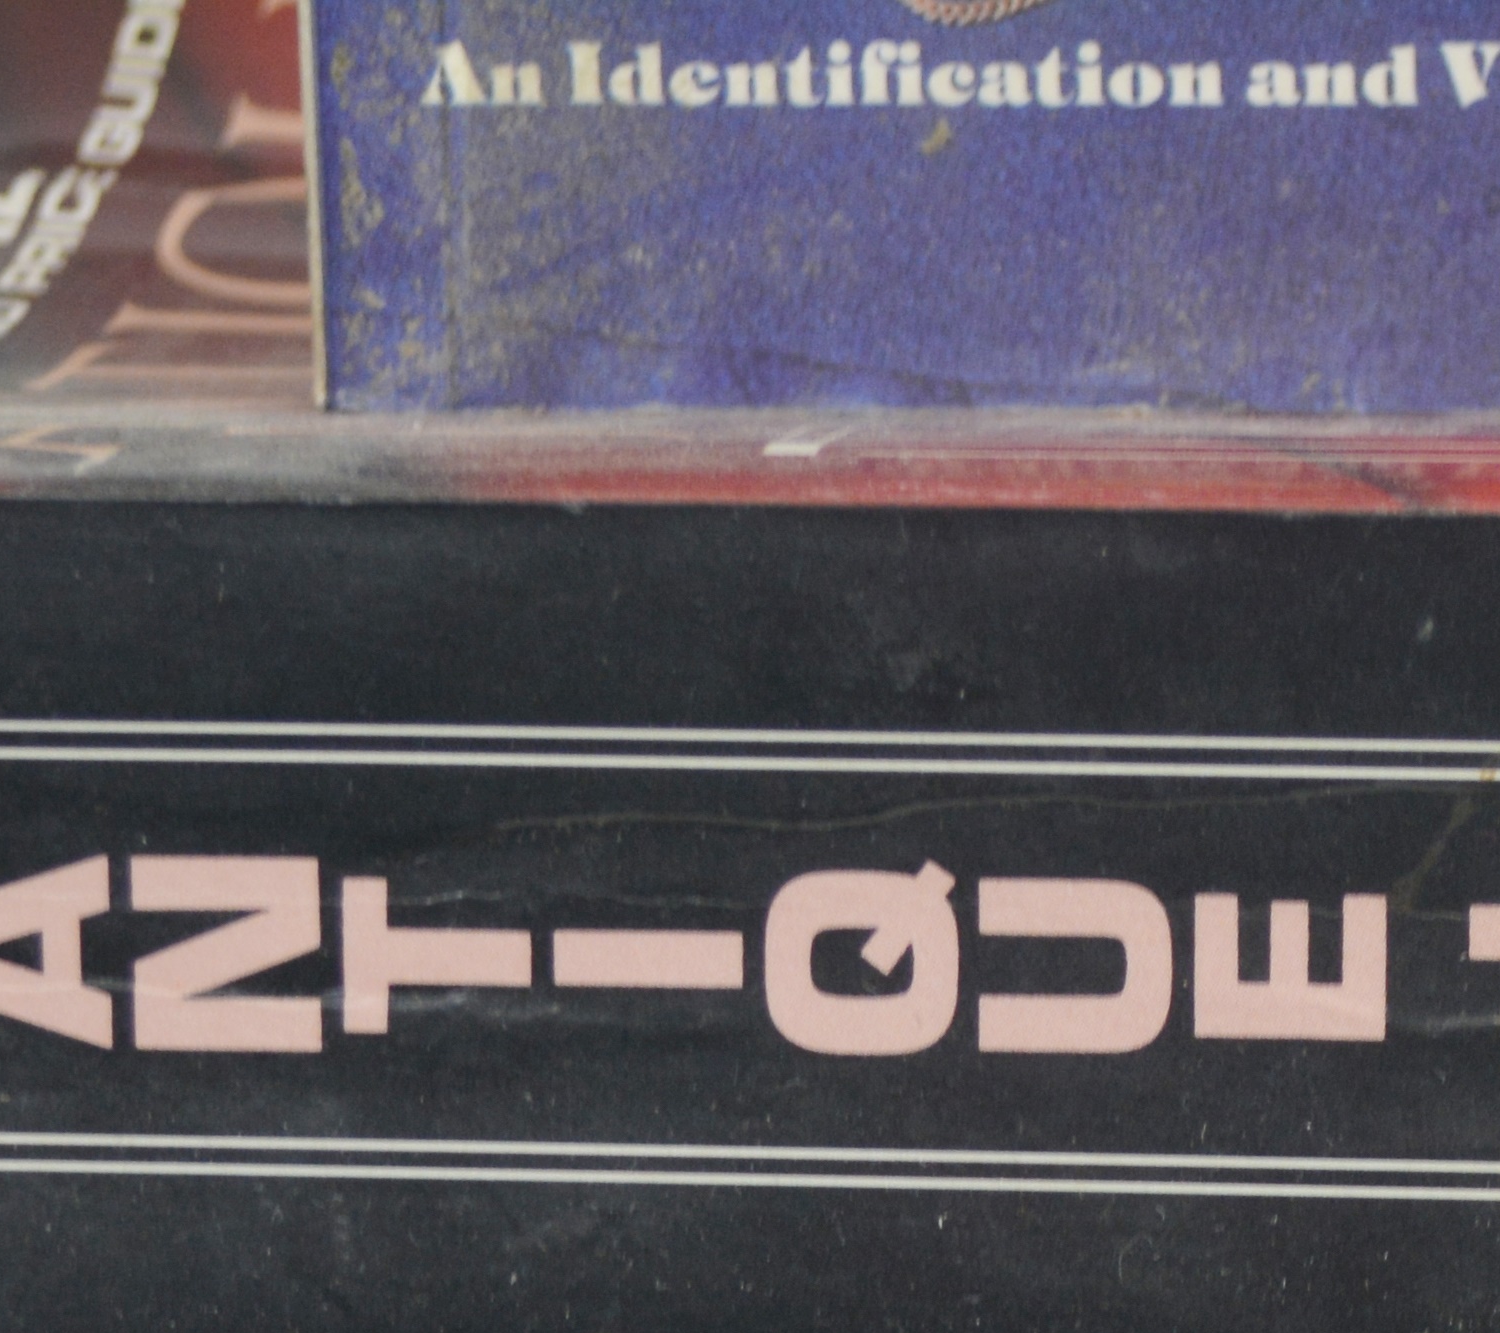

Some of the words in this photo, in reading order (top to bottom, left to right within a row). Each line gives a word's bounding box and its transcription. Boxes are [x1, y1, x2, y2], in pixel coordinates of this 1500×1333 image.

[77, 0, 188, 172] GUID
[420, 39, 546, 107] An
[566, 39, 1224, 109] Identification
[1245, 43, 1418, 109] and
